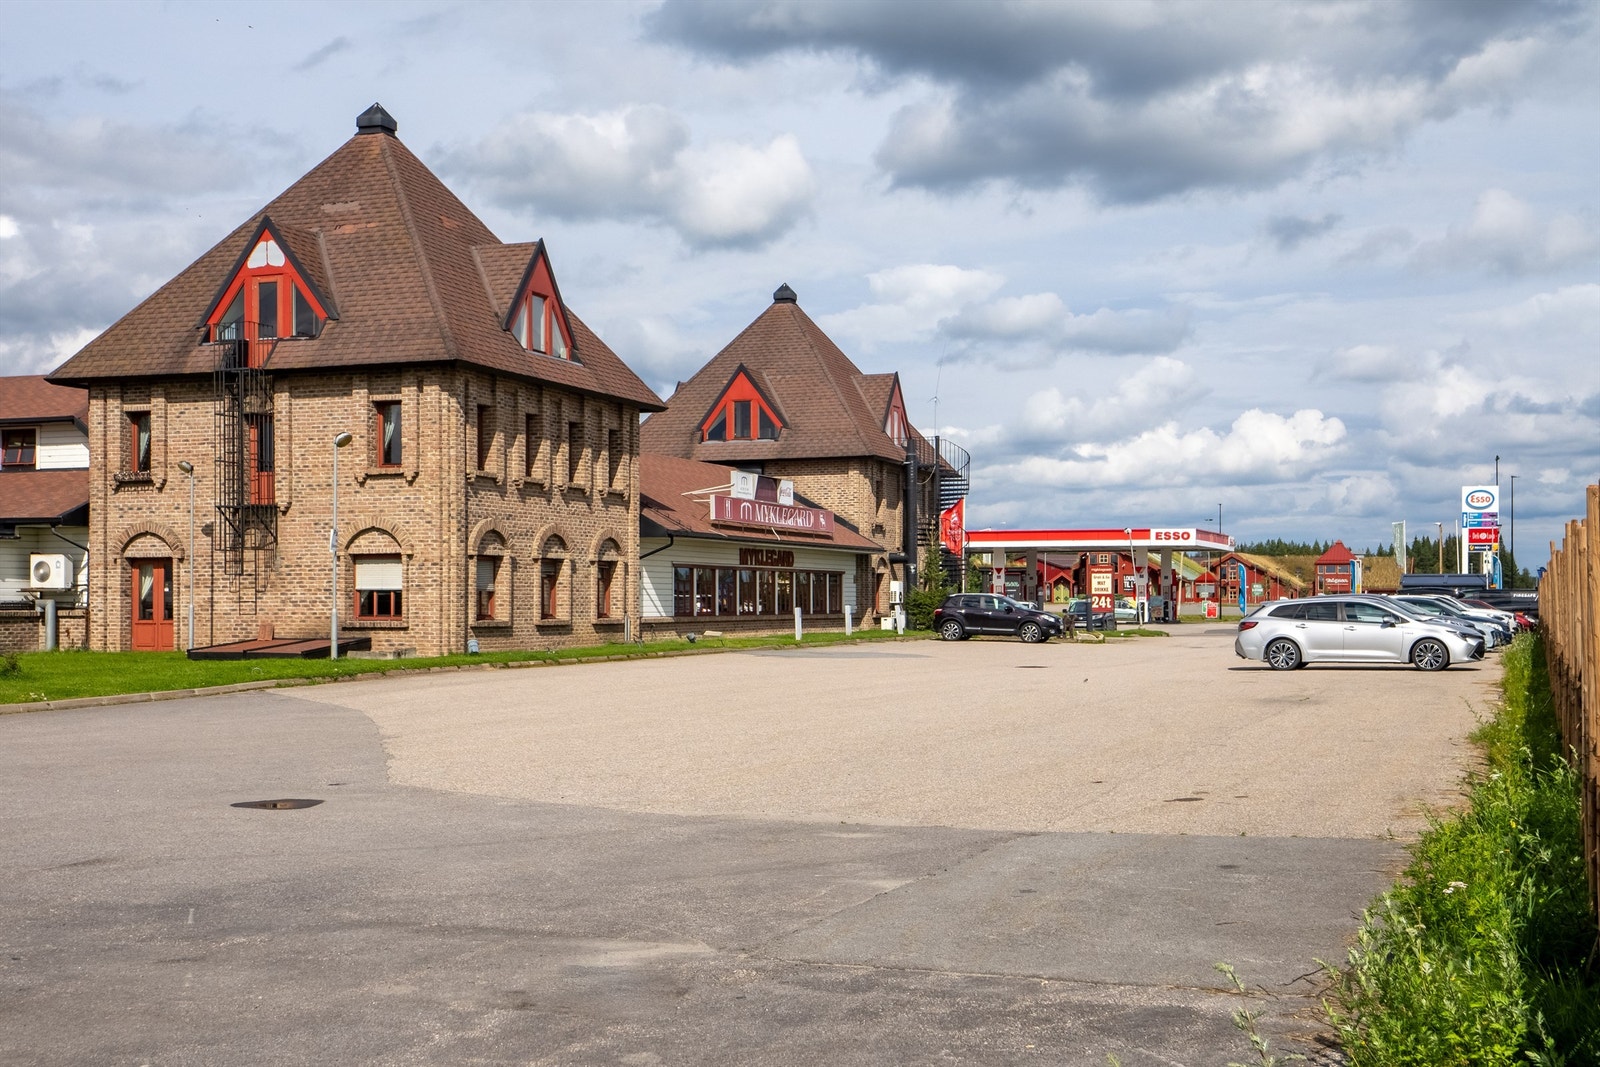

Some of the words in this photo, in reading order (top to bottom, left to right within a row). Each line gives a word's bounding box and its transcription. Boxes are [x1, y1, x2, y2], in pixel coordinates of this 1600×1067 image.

[1470, 494, 1491, 503] Esso
[755, 504, 814, 528] MYKLEGARD
[1155, 532, 1190, 540] ESSO
[739, 548, 794, 567] MYKLEGARD
[1092, 596, 1111, 608] 24t
